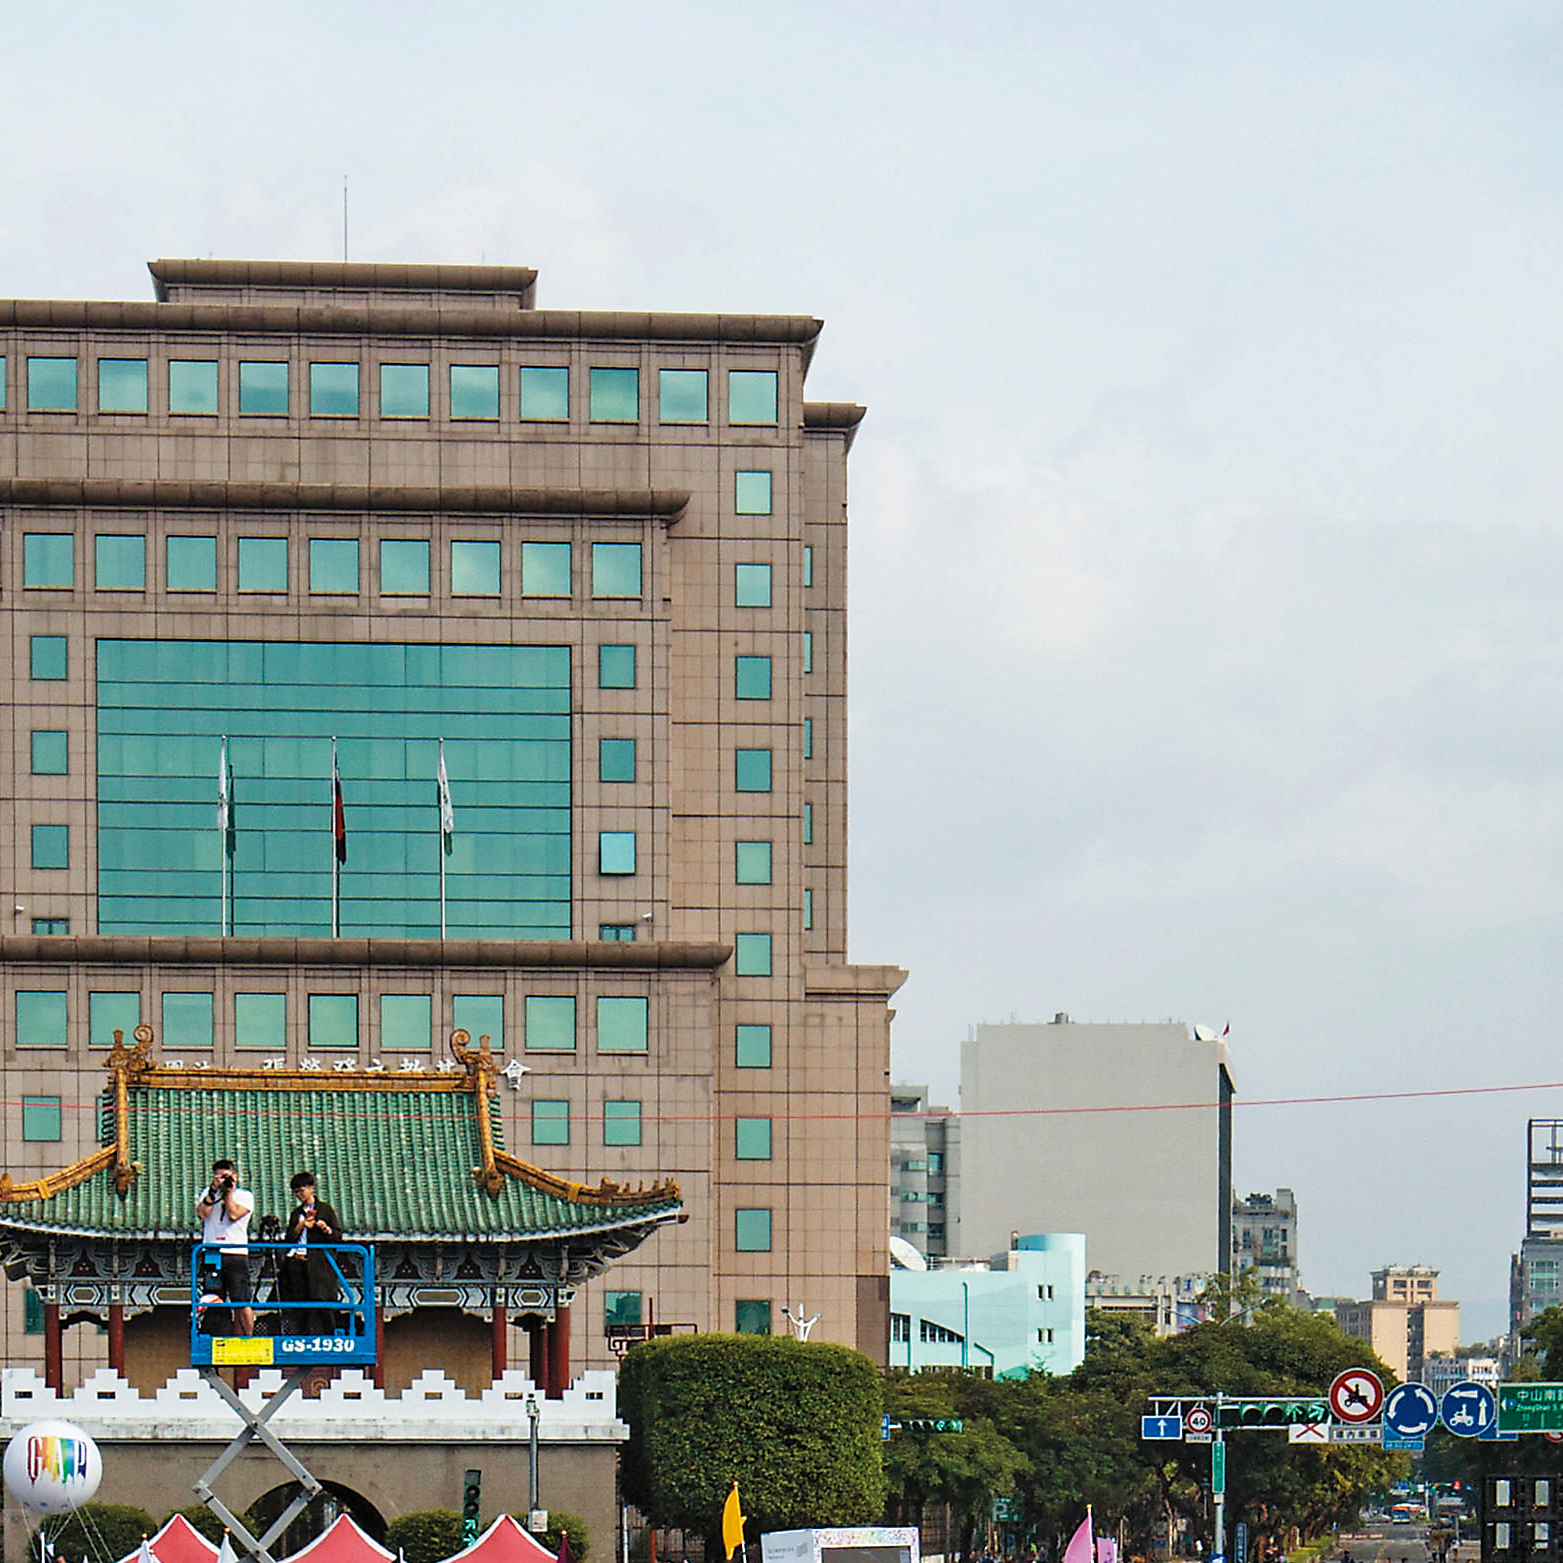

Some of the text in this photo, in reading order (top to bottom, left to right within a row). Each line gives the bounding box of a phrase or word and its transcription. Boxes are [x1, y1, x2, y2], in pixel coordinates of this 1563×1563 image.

[282, 1337, 355, 1352] GS-1930
[1193, 1417, 1205, 1426] 40
[27, 1436, 87, 1488] GAP
